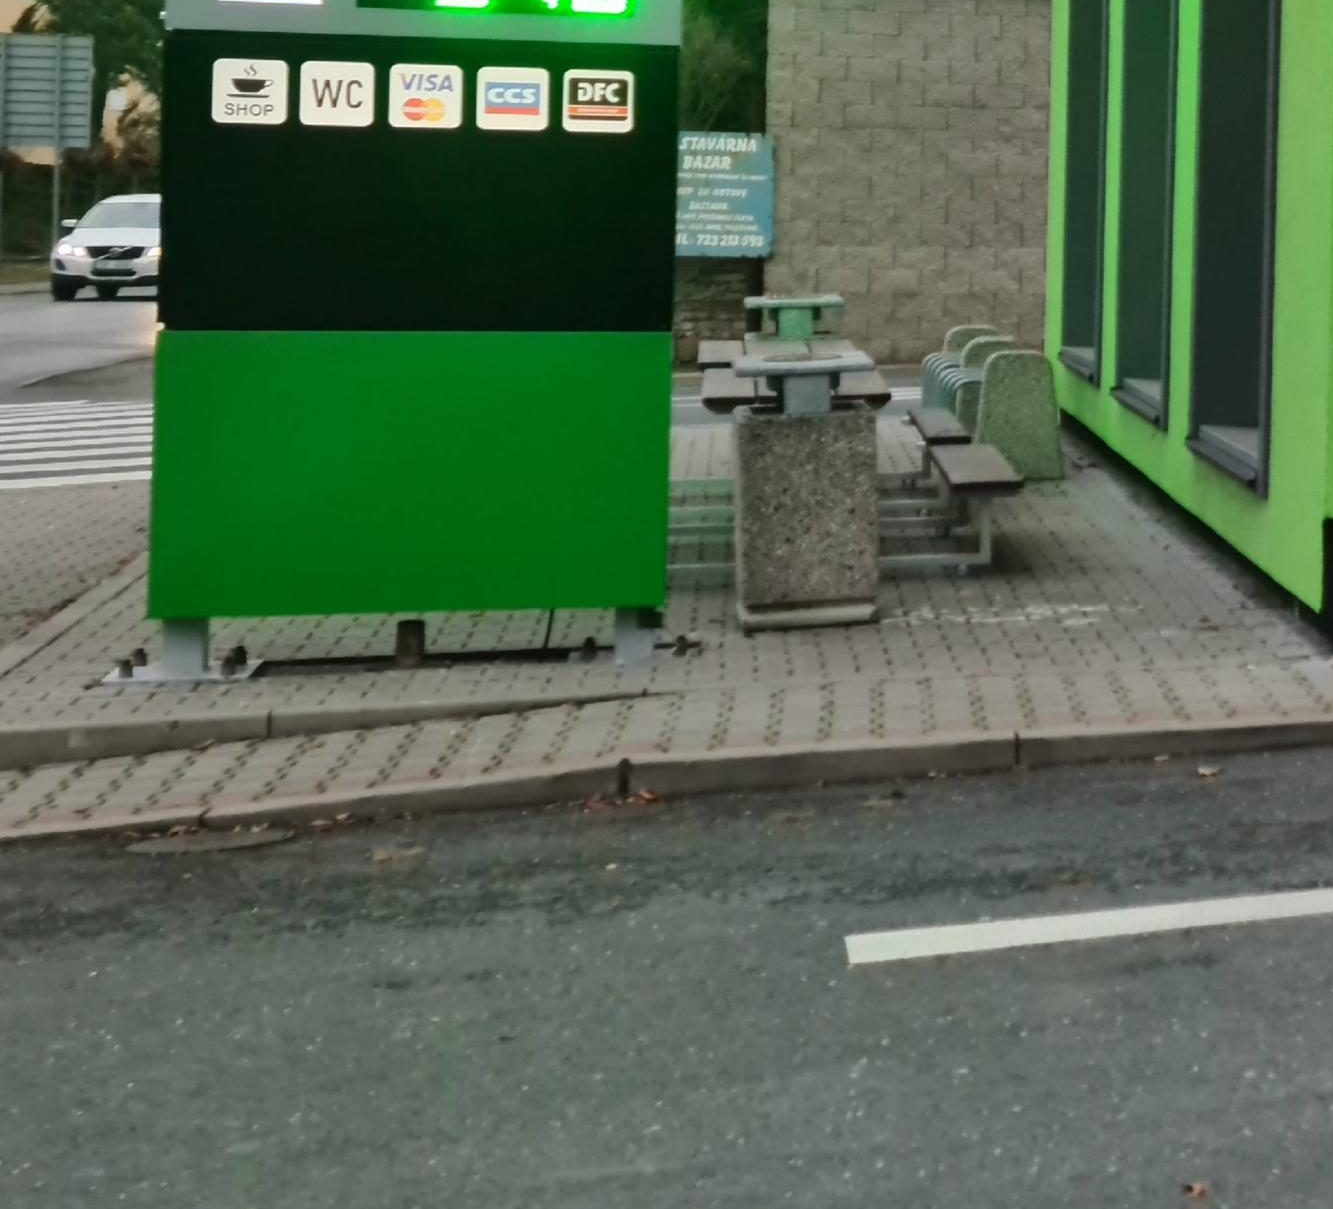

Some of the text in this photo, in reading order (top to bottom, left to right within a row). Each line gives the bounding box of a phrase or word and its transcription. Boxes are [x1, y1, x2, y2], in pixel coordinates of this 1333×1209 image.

[401, 73, 454, 92] VISA
[312, 78, 364, 109] WC
[487, 87, 537, 104] CCS
[577, 82, 620, 103] DFC
[223, 102, 275, 117] SHOP
[682, 155, 732, 170] BAZAR
